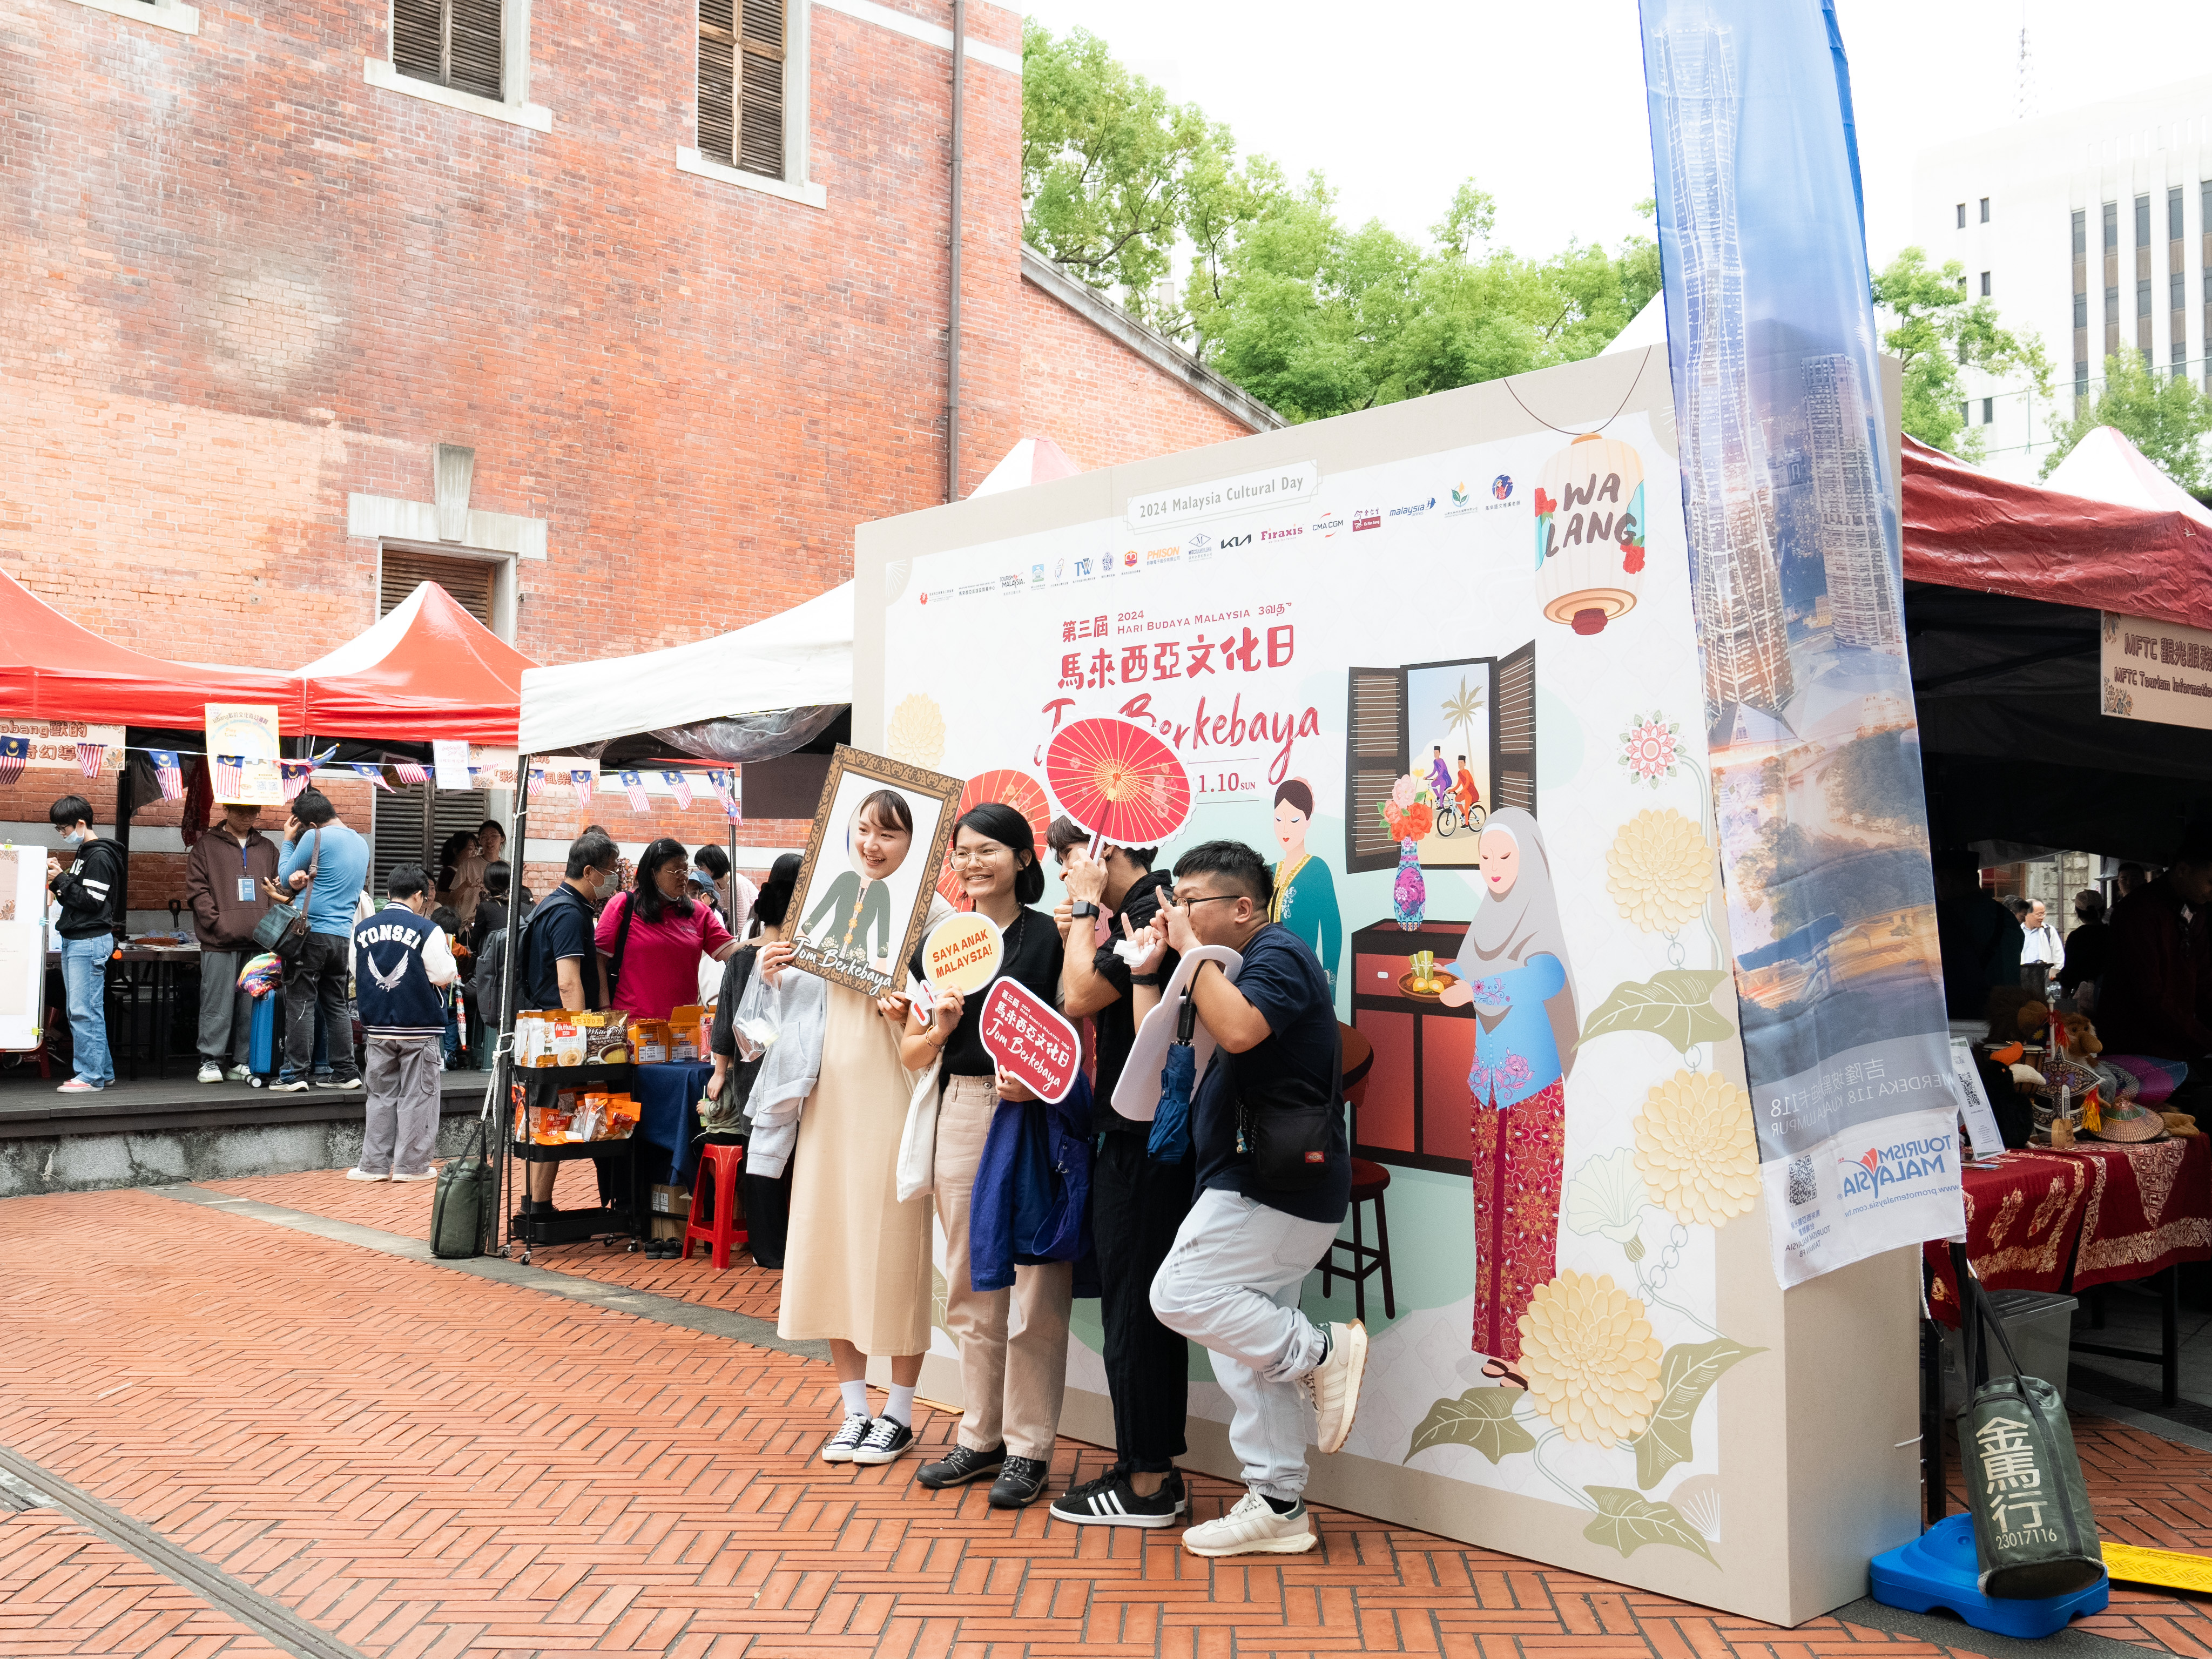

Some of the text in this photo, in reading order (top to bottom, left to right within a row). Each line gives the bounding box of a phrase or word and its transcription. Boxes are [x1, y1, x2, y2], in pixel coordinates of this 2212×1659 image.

[1140, 476, 1303, 518] 2024 Malaysia Cultural Day
[1564, 473, 1620, 511] WA
[1390, 504, 1425, 516] malaysia
[1261, 523, 1303, 541] Firaxis
[1313, 520, 1343, 531] CMA CGM
[1546, 511, 1637, 557] LANG
[1147, 546, 1180, 560] PHISON
[1221, 534, 1252, 549] KIA
[1063, 615, 1108, 643] 第三屆
[1117, 610, 1144, 622] 2024
[1117, 624, 1143, 635] HARI
[1147, 618, 1190, 631] BUDAYA
[1195, 610, 1250, 624] MALAYSIA
[1057, 624, 1293, 690] 馬來西亞文化日
[2125, 632, 2157, 660] MFTC
[2114, 666, 2212, 698] MFTC Tourism Informatio
[1240, 781, 1256, 790] SUN
[357, 924, 422, 950] YONSEI
[933, 929, 988, 962] SAYA ANAK
[791, 936, 892, 996] Jom Berkebaya
[936, 944, 992, 978] MALAYSIA!
[1001, 989, 1020, 1008] 第三屆
[1021, 1004, 1031, 1013] 2024
[995, 1000, 1069, 1068] 馬來西亞文化日
[1020, 1008, 1029, 1017] HARI
[1029, 1015, 1042, 1028] BUDAYA
[1043, 1026, 1060, 1042] MALAYSIA
[986, 1018, 1061, 1091] Jom Berkebaya
[1995, 1528, 2057, 1550] 23017116
